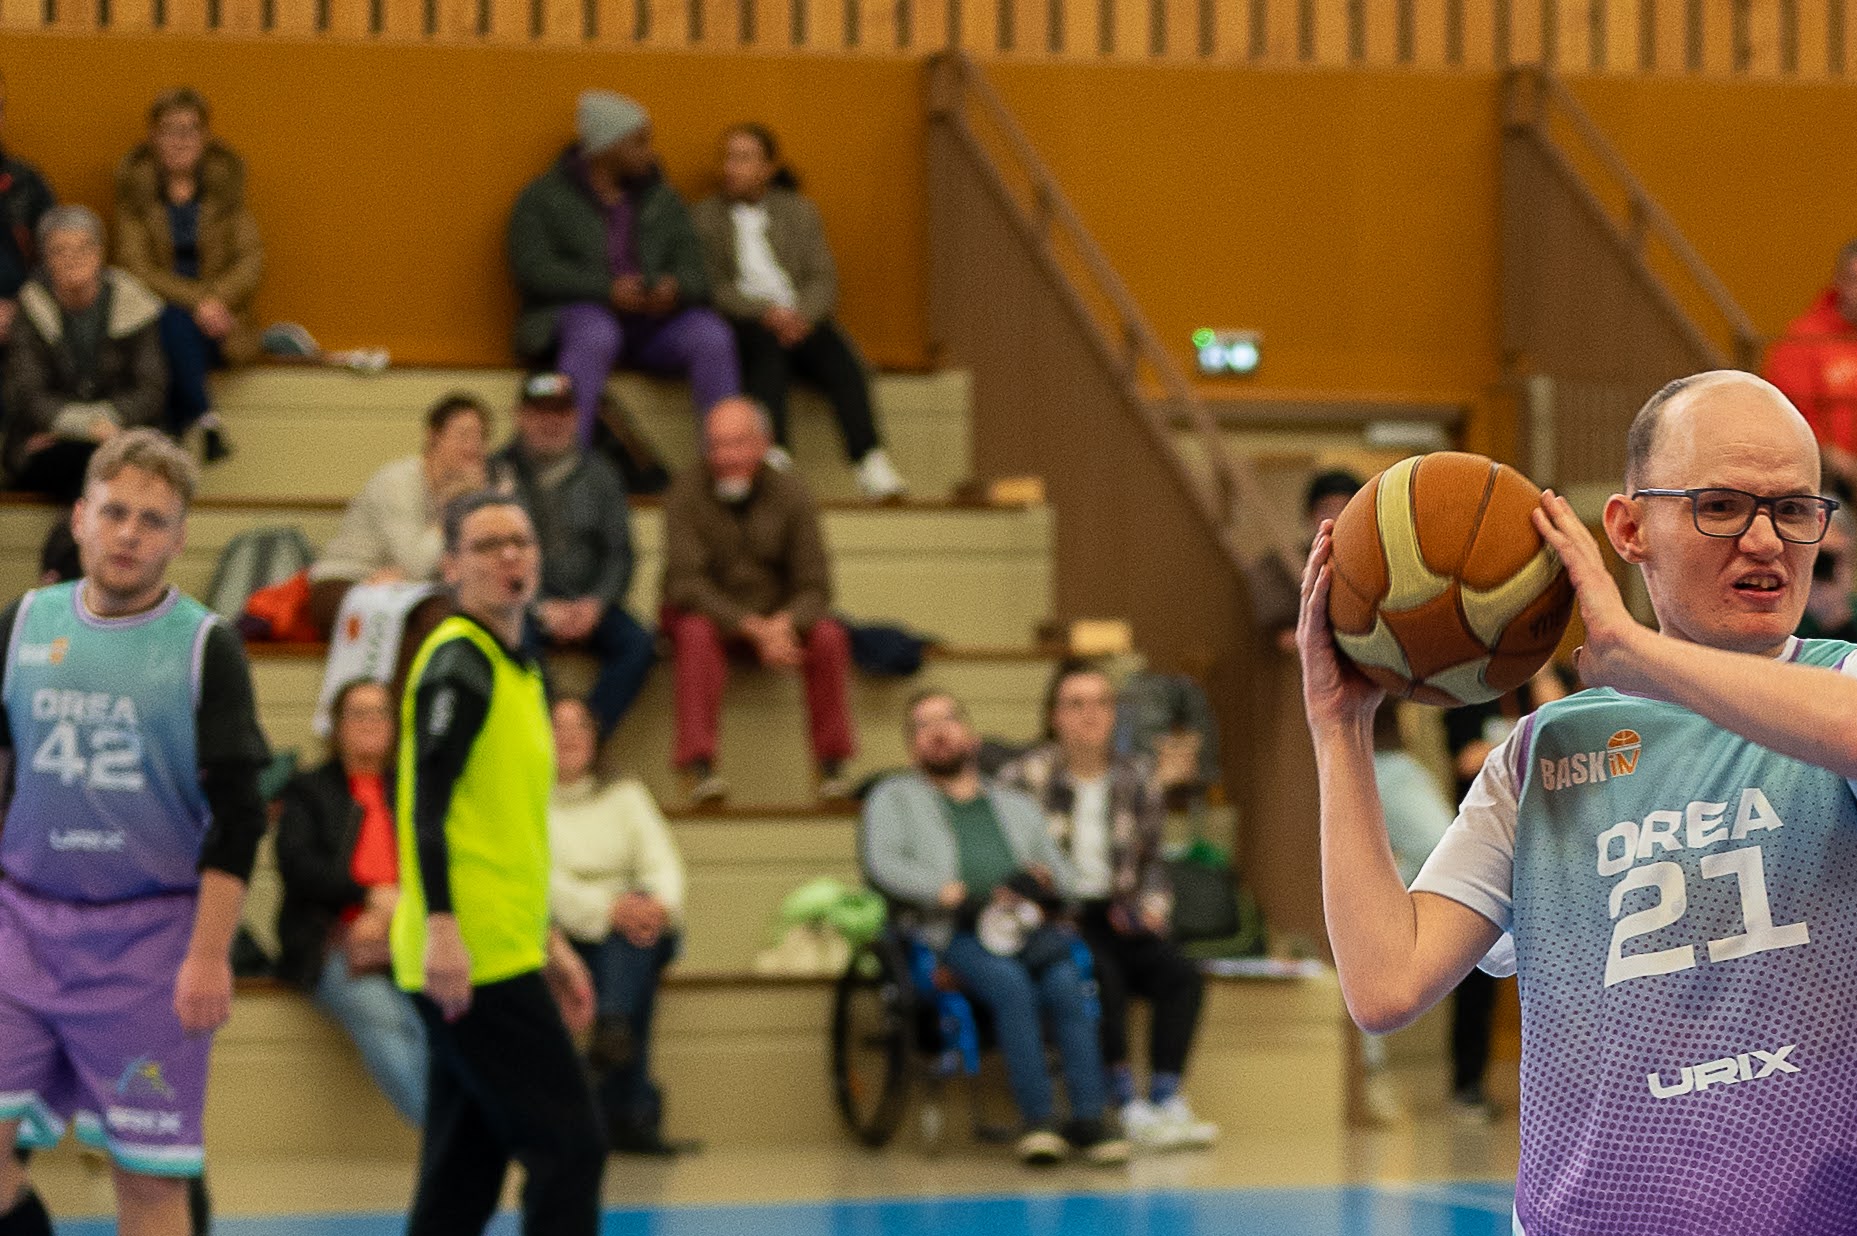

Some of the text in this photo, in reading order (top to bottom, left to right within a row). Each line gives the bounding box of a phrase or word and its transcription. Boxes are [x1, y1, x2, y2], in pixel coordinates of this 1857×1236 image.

[33, 688, 138, 726] OREA
[33, 719, 145, 791] 42
[1597, 788, 1784, 876] OREA
[1604, 845, 1810, 988] 21
[1646, 1044, 1801, 1099] URIX
